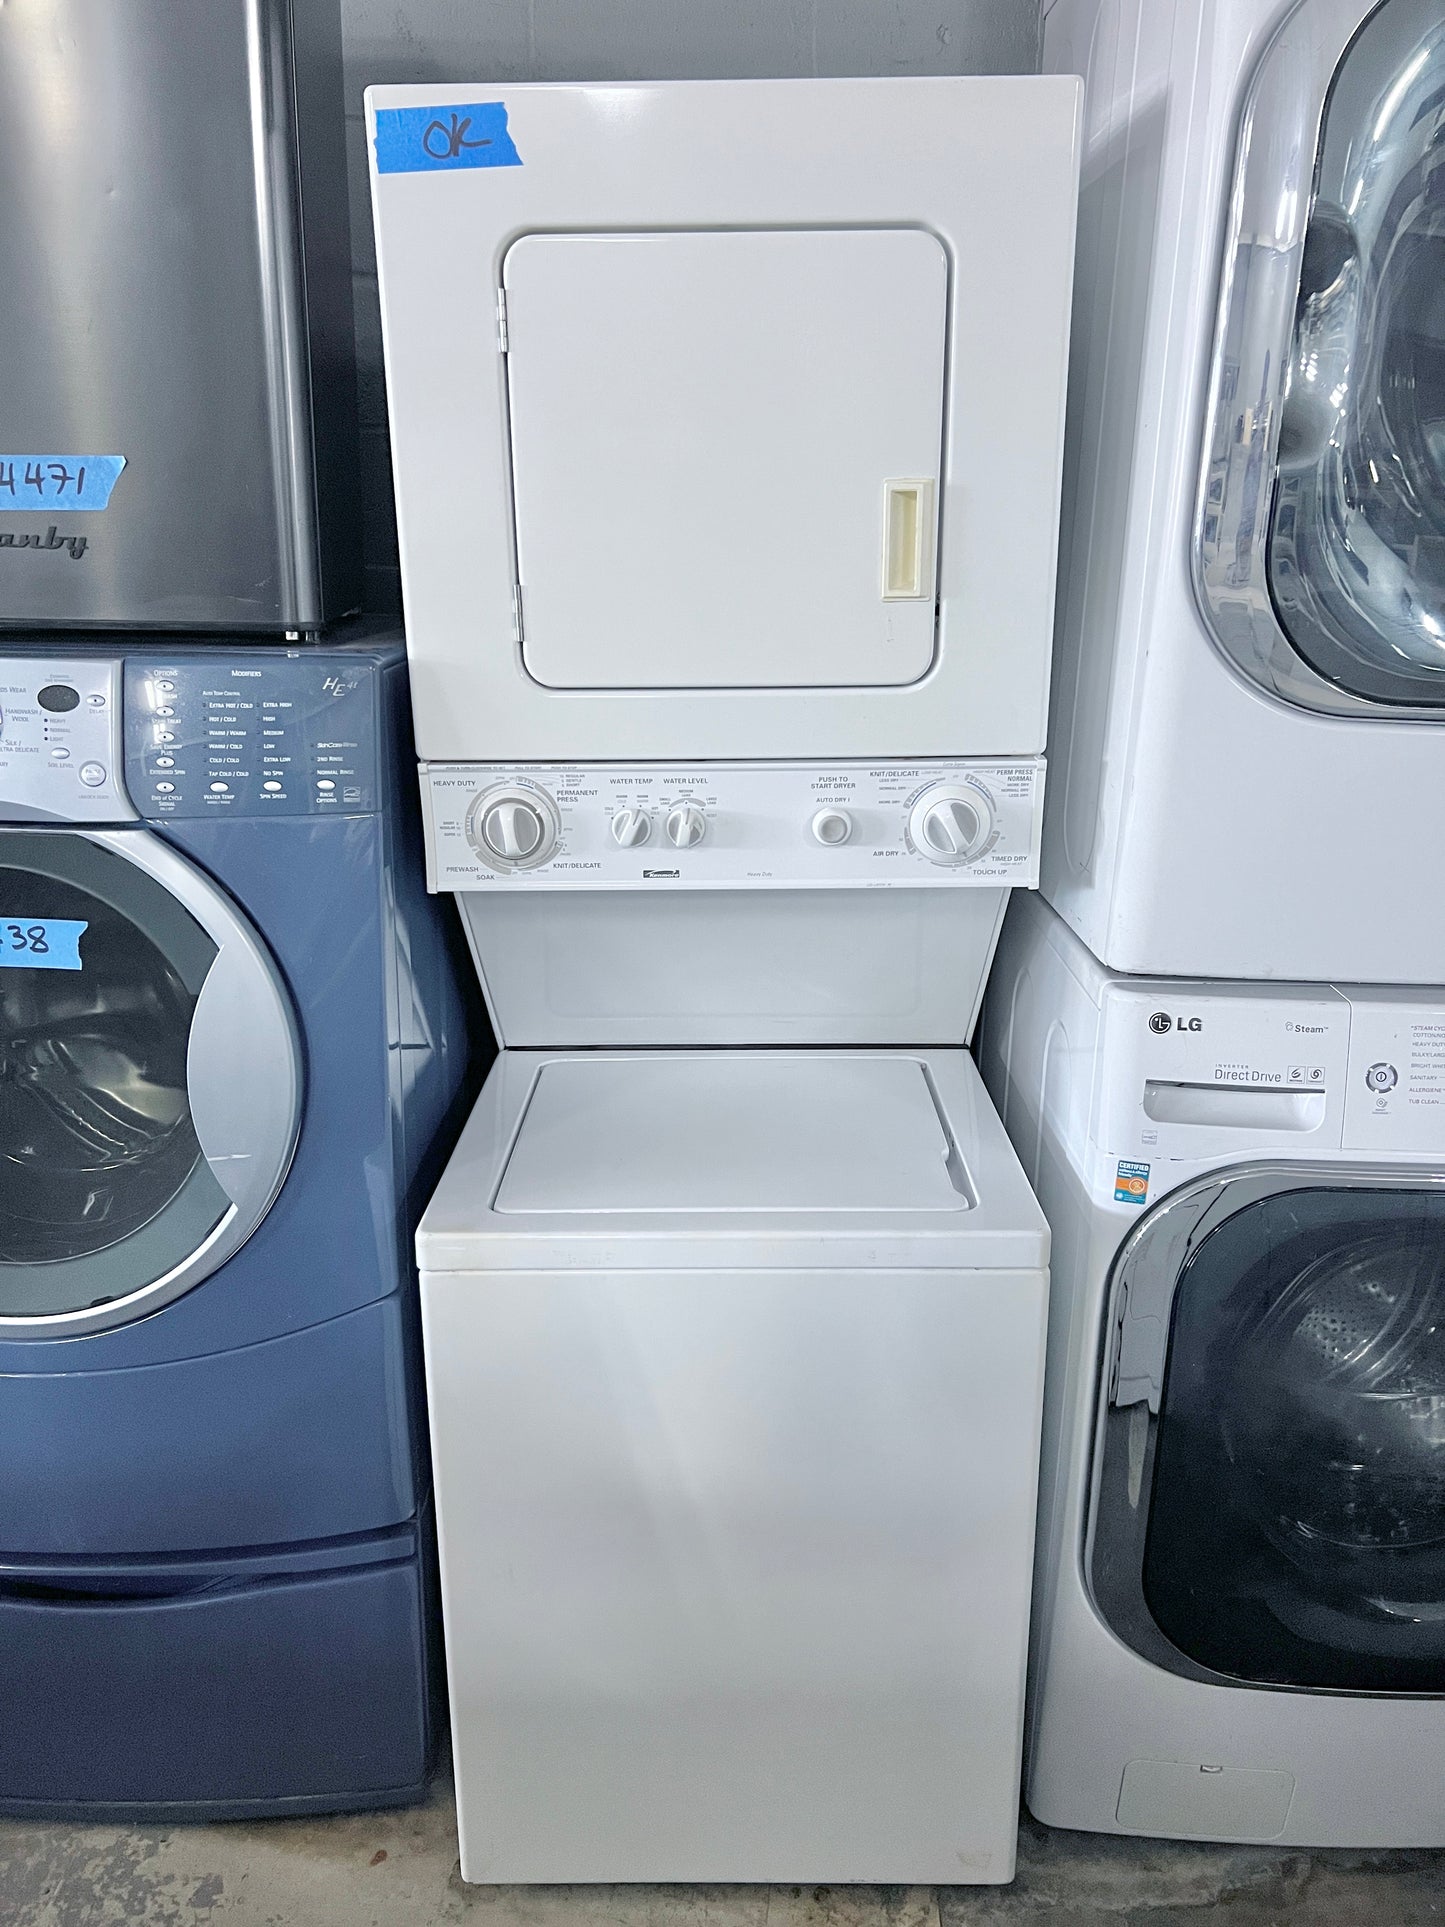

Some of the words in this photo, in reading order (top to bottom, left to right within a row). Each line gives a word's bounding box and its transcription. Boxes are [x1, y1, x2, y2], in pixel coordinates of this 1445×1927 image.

[423, 113, 493, 159] OK
[0, 925, 49, 953] 38
[1177, 1017, 1202, 1032] LG
[1119, 1161, 1149, 1171] CERTIFIED
